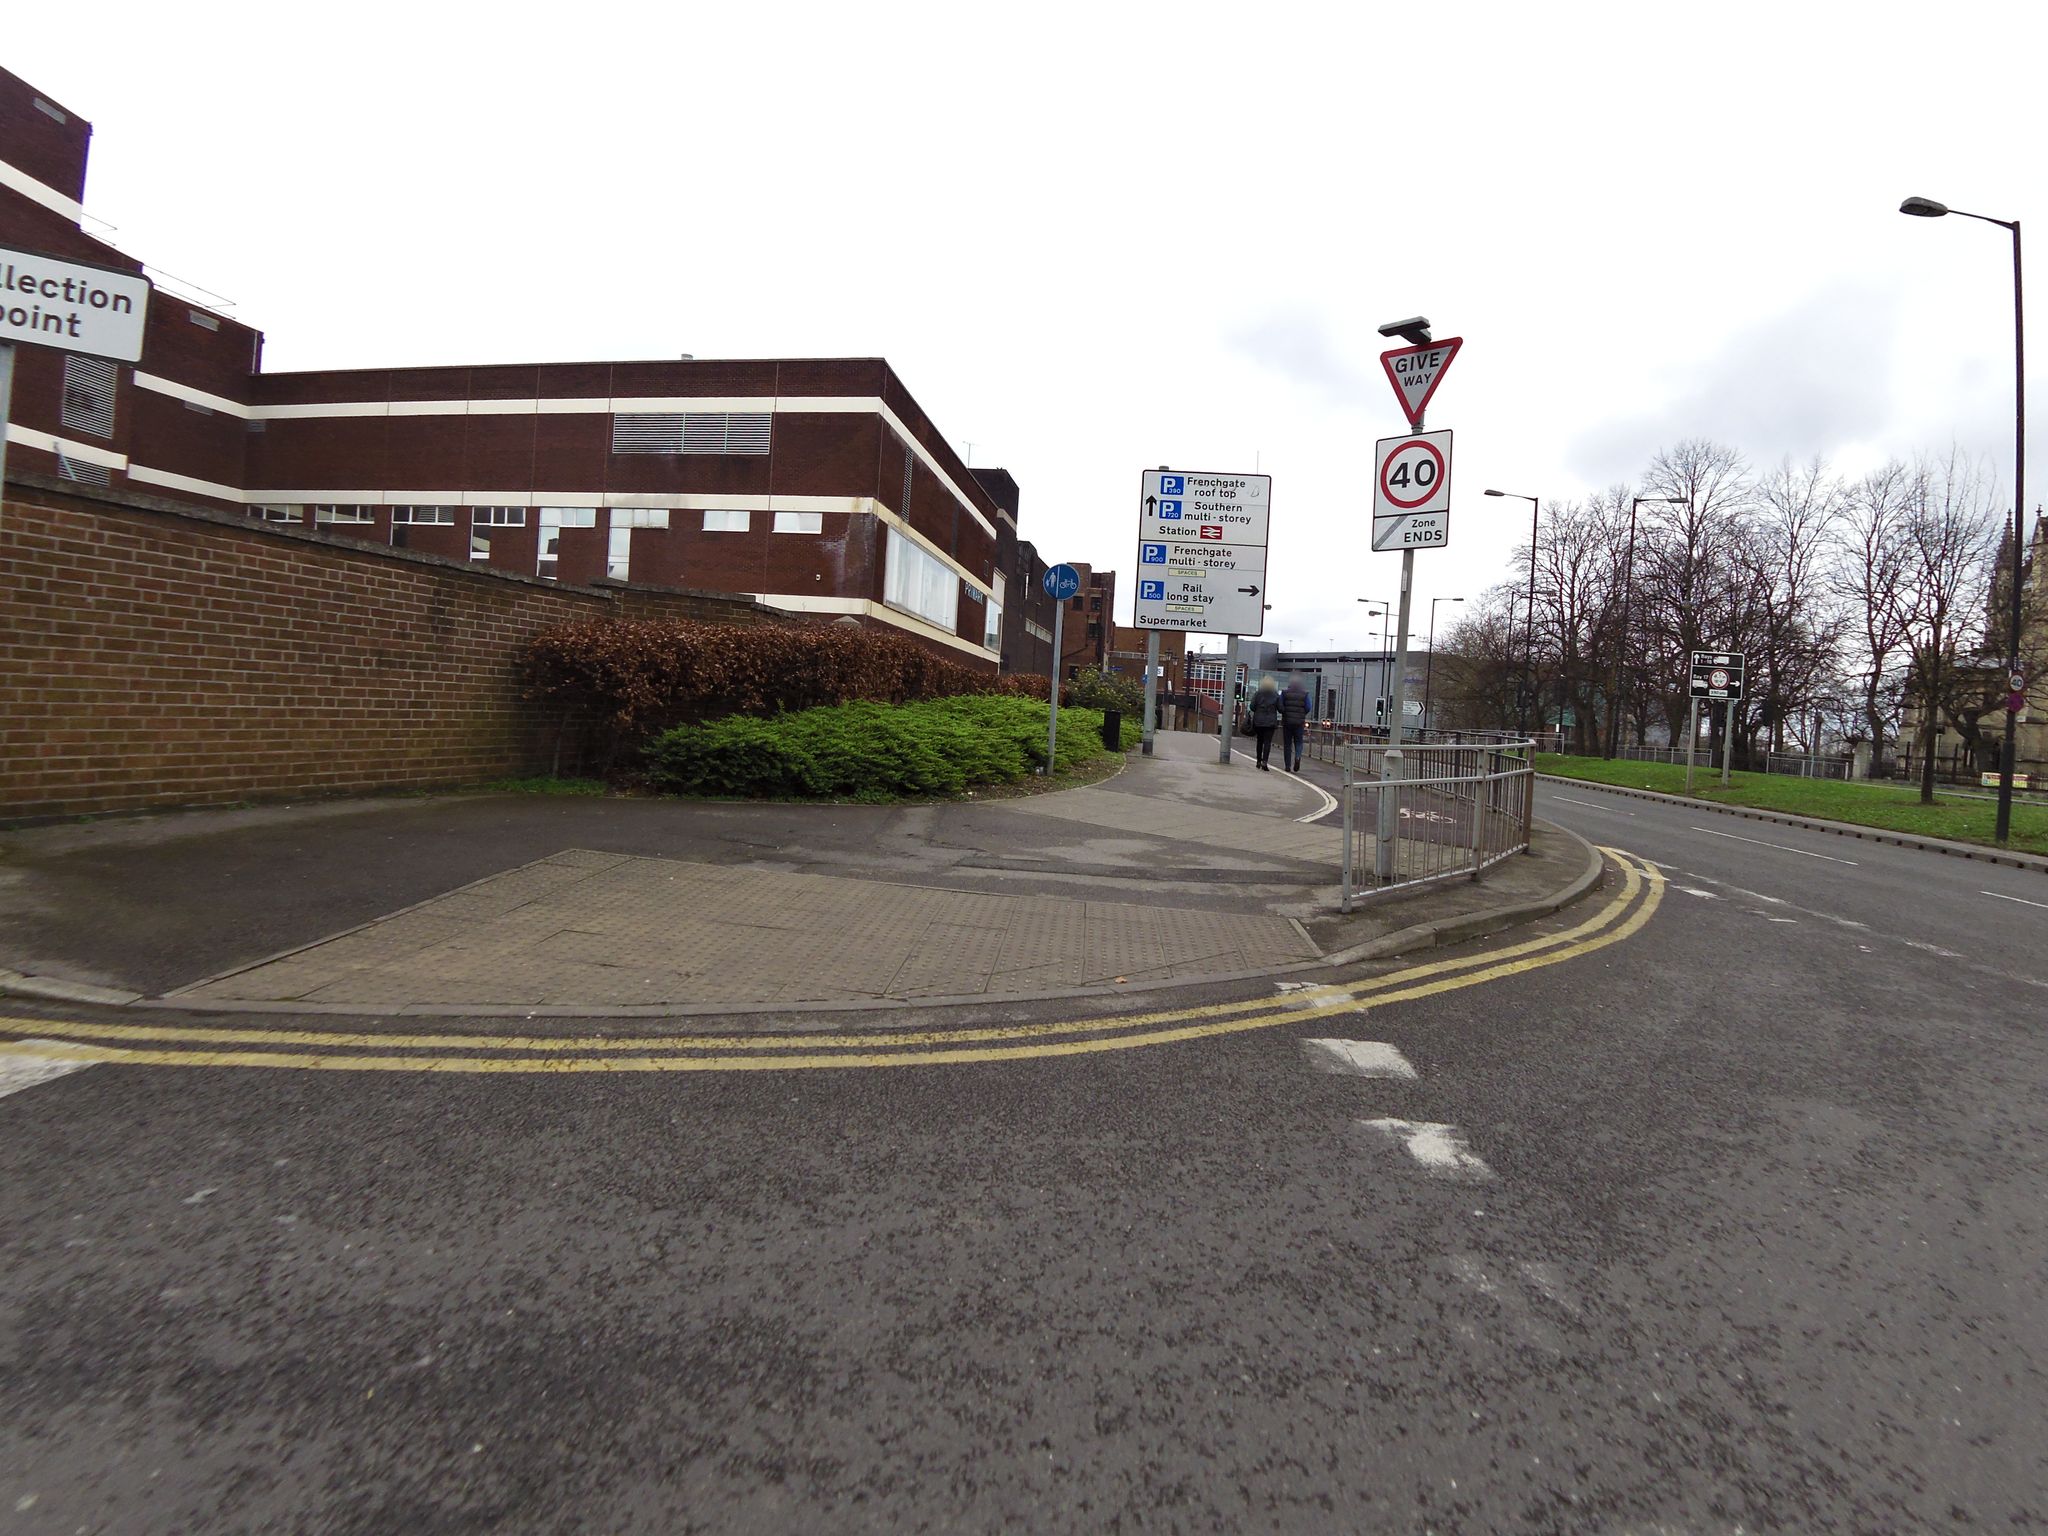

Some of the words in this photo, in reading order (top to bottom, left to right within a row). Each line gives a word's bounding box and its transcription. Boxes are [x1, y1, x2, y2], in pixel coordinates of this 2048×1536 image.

[0, 263, 132, 314] lection
[1395, 352, 1440, 373] GIVE
[1404, 373, 1432, 387] WAY
[1389, 459, 1436, 488] 40
[1163, 477, 1176, 493] P
[1187, 477, 1246, 489] Frenchgate
[1194, 489, 1216, 497] roof
[1219, 489, 1237, 499] top
[1162, 502, 1174, 518] P
[1194, 501, 1243, 512] Southern
[1411, 519, 1436, 528] Zone
[1158, 525, 1197, 536] Station
[1404, 530, 1443, 543] ENDS
[1145, 546, 1158, 562] P
[1174, 546, 1232, 557] Frenchgate
[1143, 582, 1156, 598] P
[1182, 584, 1202, 592] Rail
[1166, 591, 1189, 602] long
[1192, 594, 1214, 604] stay
[1140, 615, 1207, 628] Supermarket
